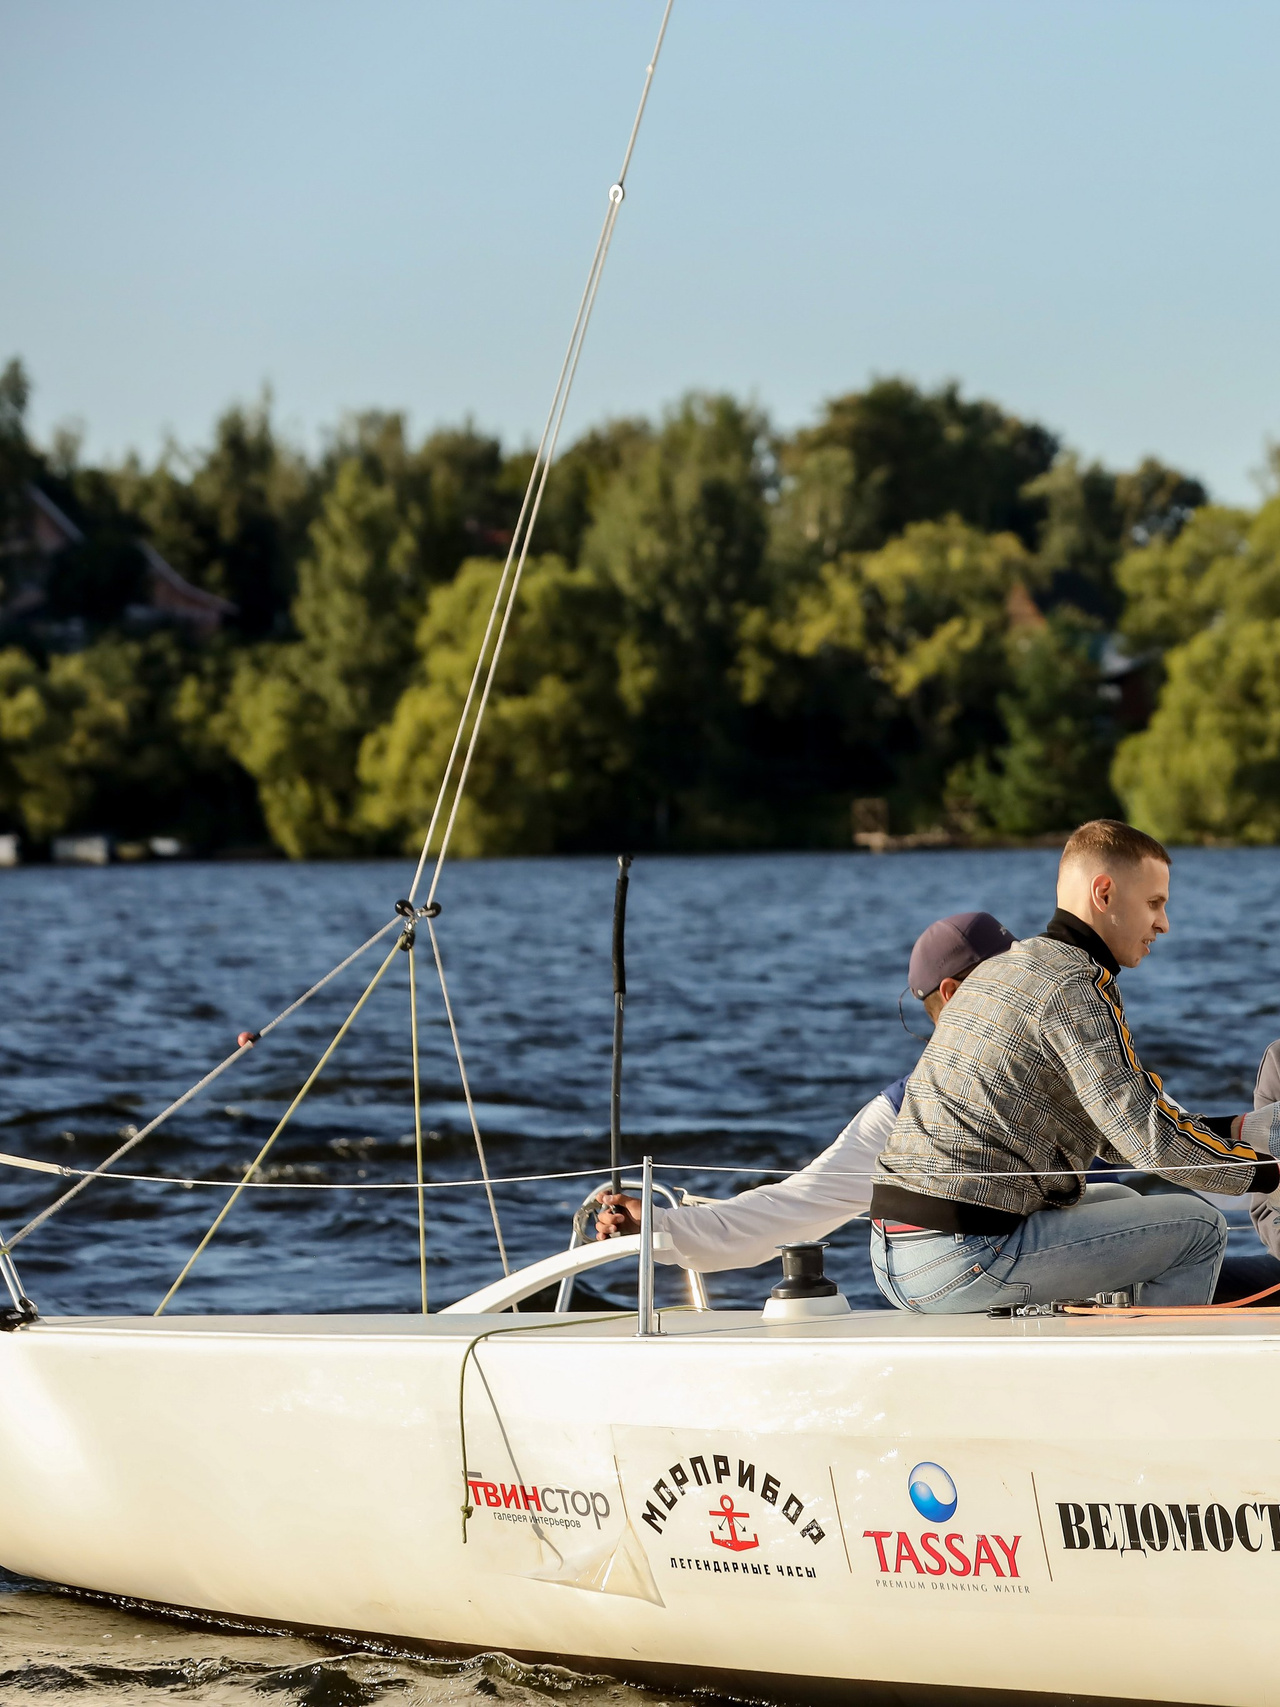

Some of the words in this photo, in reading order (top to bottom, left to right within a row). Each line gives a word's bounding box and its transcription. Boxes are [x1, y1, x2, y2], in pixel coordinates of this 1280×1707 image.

[641, 1454, 826, 1545] МОРПРИБОР
[493, 1511, 528, 1524] галерея
[528, 1514, 582, 1530] интерьеров
[862, 1530, 1022, 1578] TASSAY
[670, 1557, 771, 1576] ЛЕГЕНДАРНЫЕ
[776, 1565, 817, 1579] ЧАСЫ
[875, 1579, 926, 1591] PREMIUM
[931, 1581, 988, 1593] DRINKING
[993, 1584, 1031, 1594] WATER
